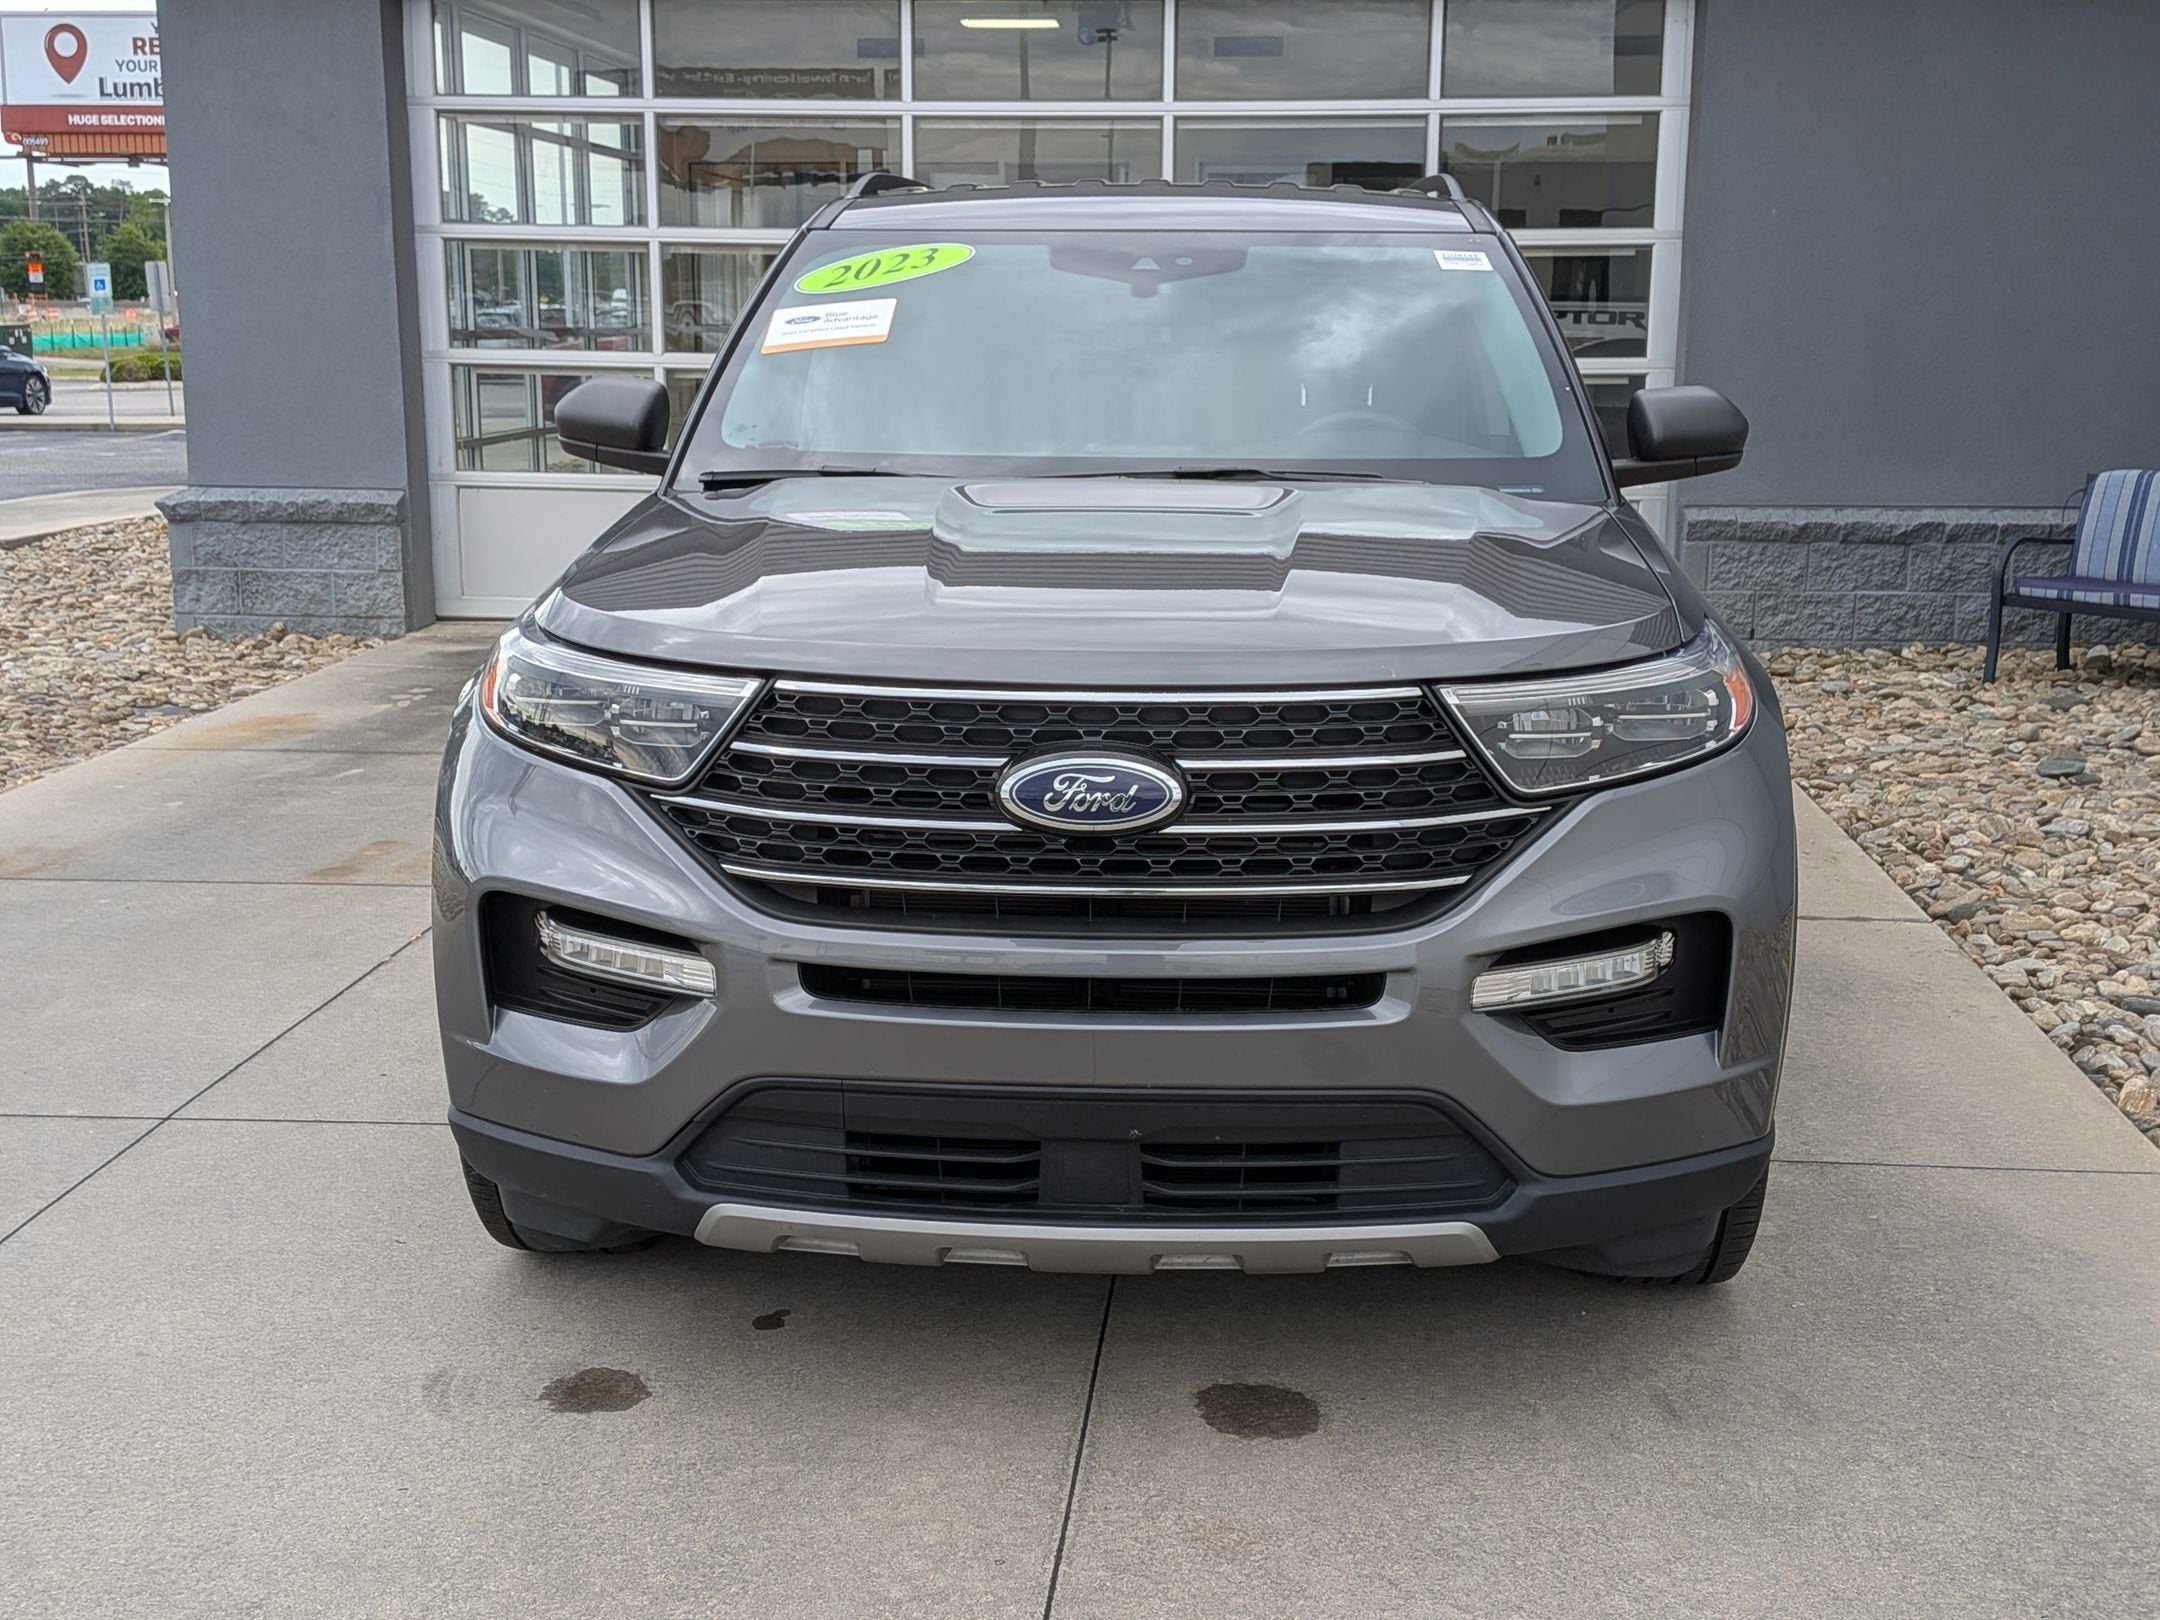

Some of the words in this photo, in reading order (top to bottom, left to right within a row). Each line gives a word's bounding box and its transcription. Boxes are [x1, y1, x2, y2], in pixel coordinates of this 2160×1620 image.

[115, 60, 158, 73] YOUR
[68, 114, 99, 126] HUGE
[823, 248, 939, 288] 2023
[823, 314, 878, 324] Advantage
[1043, 773, 1139, 813] Ford
